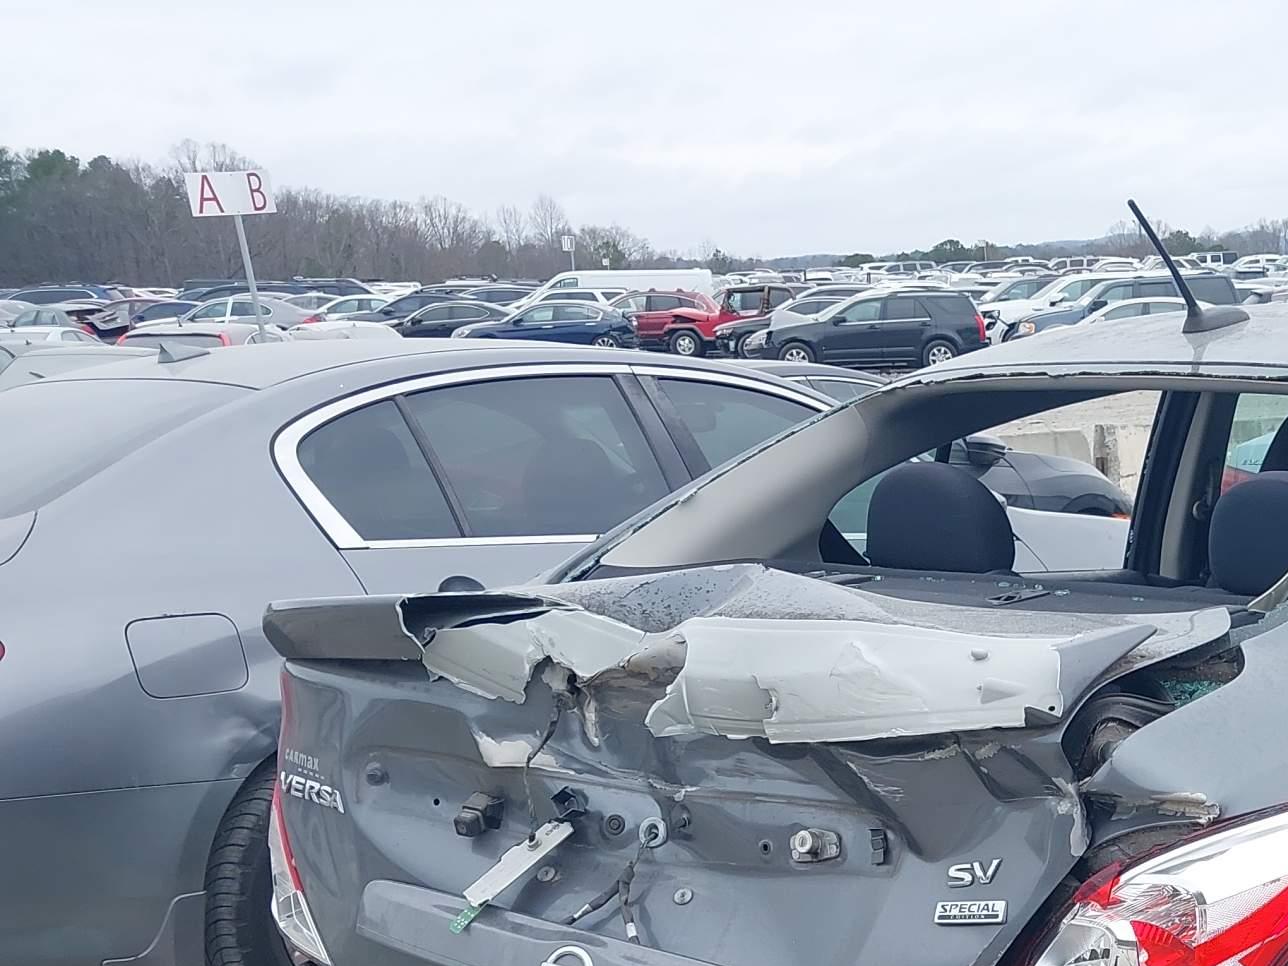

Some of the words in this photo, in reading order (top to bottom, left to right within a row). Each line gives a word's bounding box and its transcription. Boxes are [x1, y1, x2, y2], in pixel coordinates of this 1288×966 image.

[199, 174, 225, 214] A
[246, 172, 267, 211] B
[280, 771, 345, 814] VERSA
[947, 858, 1003, 888] SV
[938, 903, 1000, 914] SPECIAL
